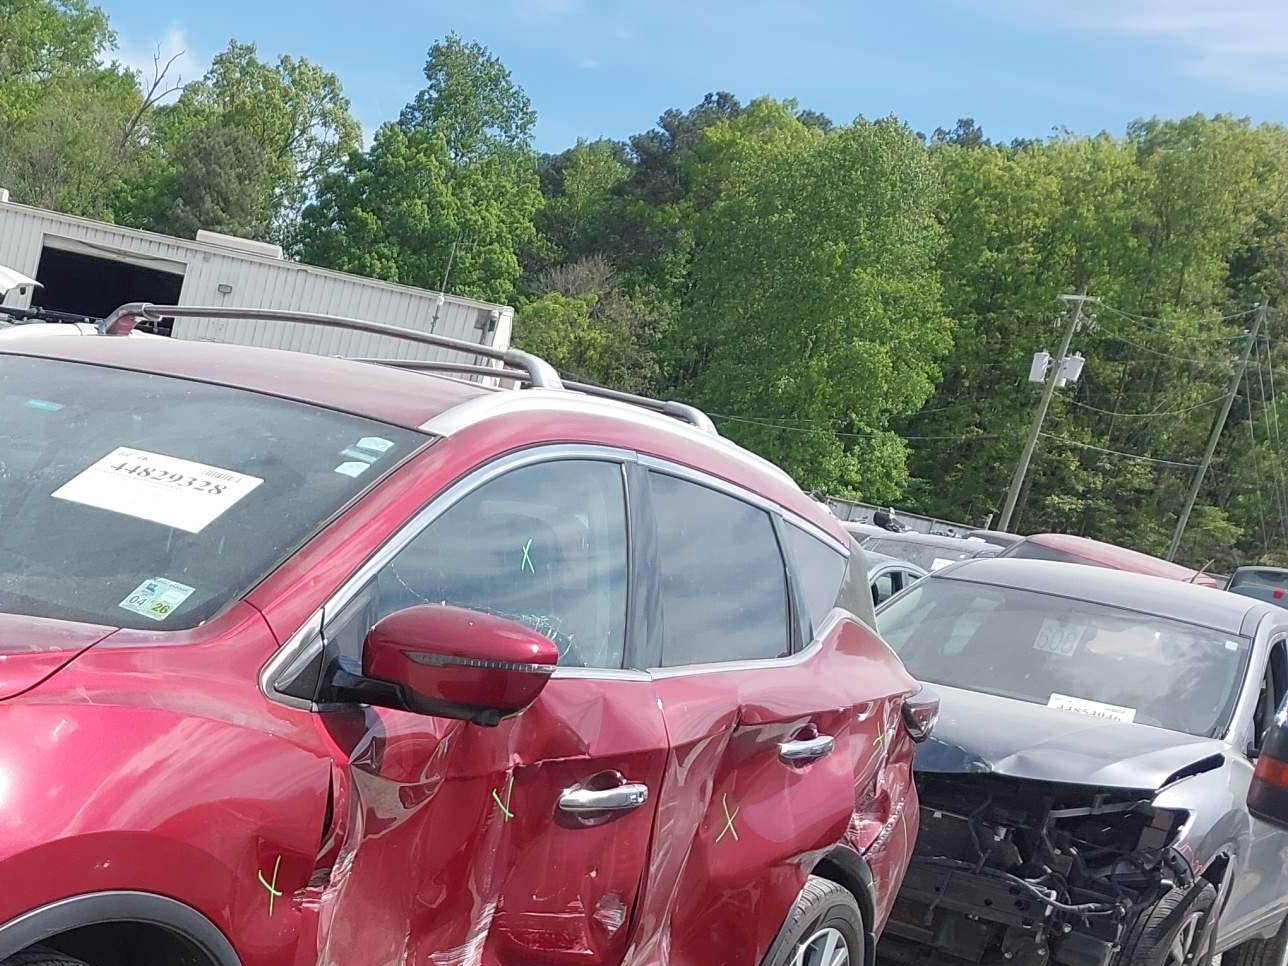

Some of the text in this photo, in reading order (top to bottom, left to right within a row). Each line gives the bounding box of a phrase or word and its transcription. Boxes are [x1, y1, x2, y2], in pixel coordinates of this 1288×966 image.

[111, 461, 228, 495] 44829328
[129, 595, 147, 606] 04
[152, 602, 169, 614] 26
